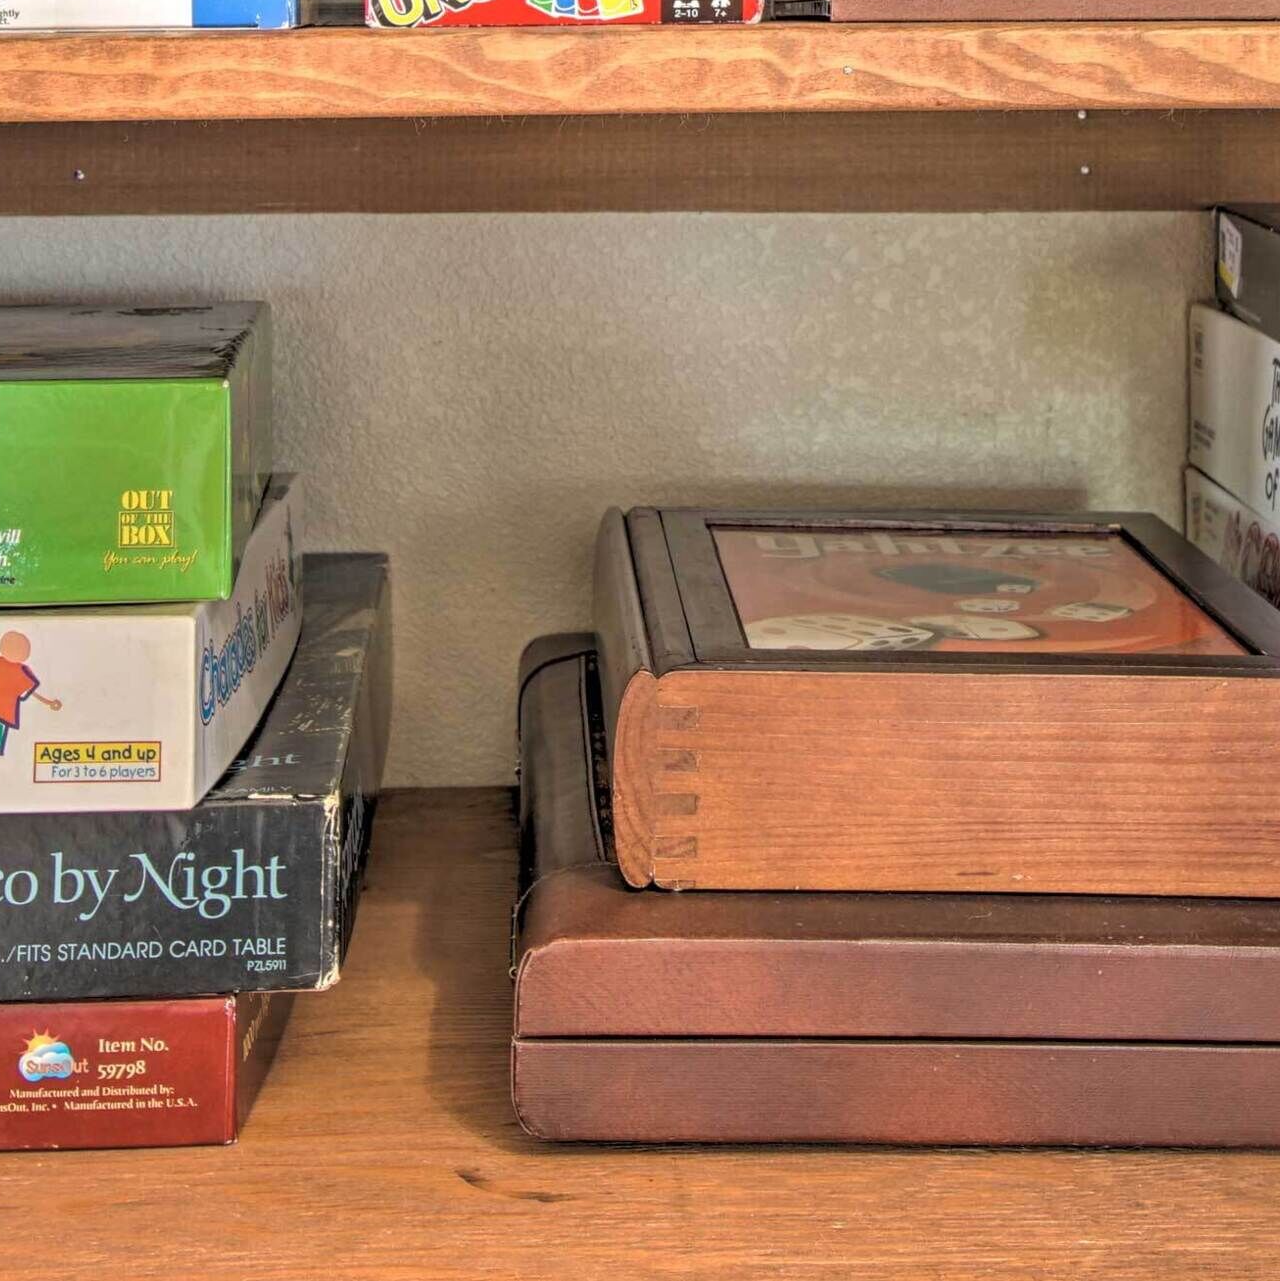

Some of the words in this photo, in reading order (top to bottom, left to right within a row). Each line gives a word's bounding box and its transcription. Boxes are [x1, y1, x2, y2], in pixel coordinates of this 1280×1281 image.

[121, 491, 172, 510] OUT
[122, 525, 171, 545] BOX
[51, 852, 116, 921] by
[123, 848, 288, 920] Night
[98, 1039, 135, 1053] Item
[140, 1038, 169, 1052] No.
[98, 1061, 145, 1079] 59798
